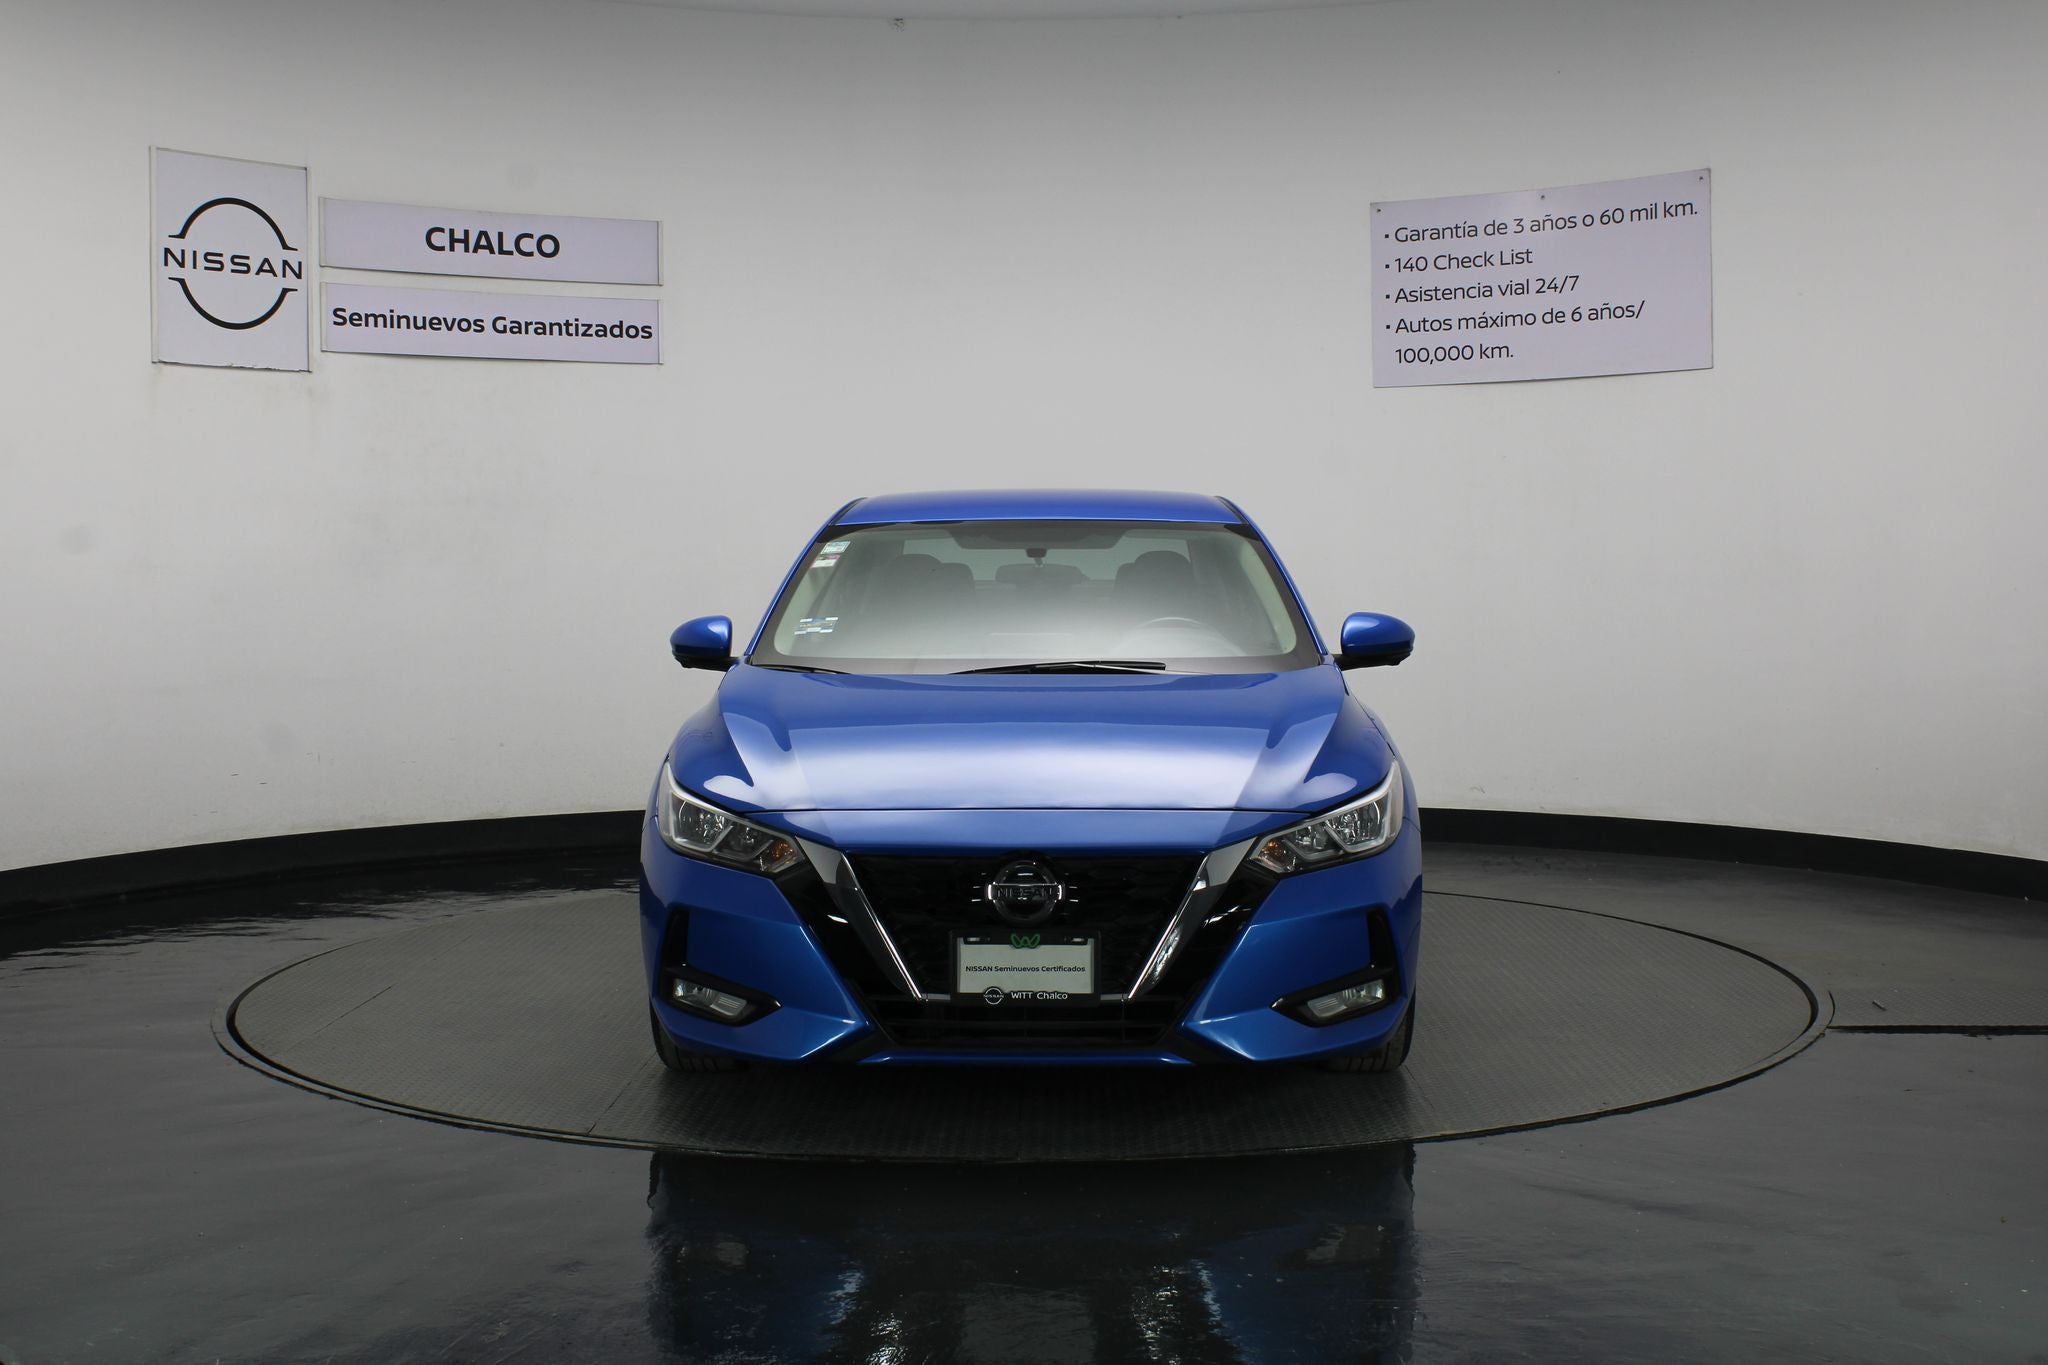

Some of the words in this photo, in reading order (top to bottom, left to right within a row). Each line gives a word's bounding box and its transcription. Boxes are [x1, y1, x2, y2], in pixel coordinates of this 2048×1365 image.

[1394, 220, 1478, 243] Garantía
[1483, 219, 1508, 236] de
[1513, 217, 1525, 234] 3
[1530, 214, 1578, 233] años
[1581, 213, 1595, 228] o
[1599, 207, 1625, 226] 60
[1629, 202, 1658, 223] mil
[1663, 201, 1699, 219] km.
[425, 226, 561, 258] CHALCO
[164, 247, 303, 280] NISSAN
[1394, 255, 1429, 273] 140
[1433, 250, 1495, 271] Check
[1499, 248, 1534, 267] List
[1394, 283, 1494, 304] Asistencia
[1497, 278, 1530, 297] vial
[1535, 274, 1581, 295] 24/7
[332, 307, 486, 334] Seminuevos
[491, 315, 653, 340] Garantizados
[1394, 317, 1453, 334] Autos
[1457, 310, 1537, 331] máximo
[1541, 306, 1566, 325] de
[1570, 305, 1583, 323] 6
[1587, 300, 1646, 322] años/
[1394, 344, 1475, 365] 100,000
[1479, 342, 1514, 360] km.
[997, 887, 1055, 898] NISSAN
[965, 965, 993, 973] NISSAN
[994, 965, 1040, 973] Seminuevos
[1040, 965, 1086, 973] Certificados
[1010, 991, 1033, 999] WITT
[1036, 991, 1068, 1000] Chalco
